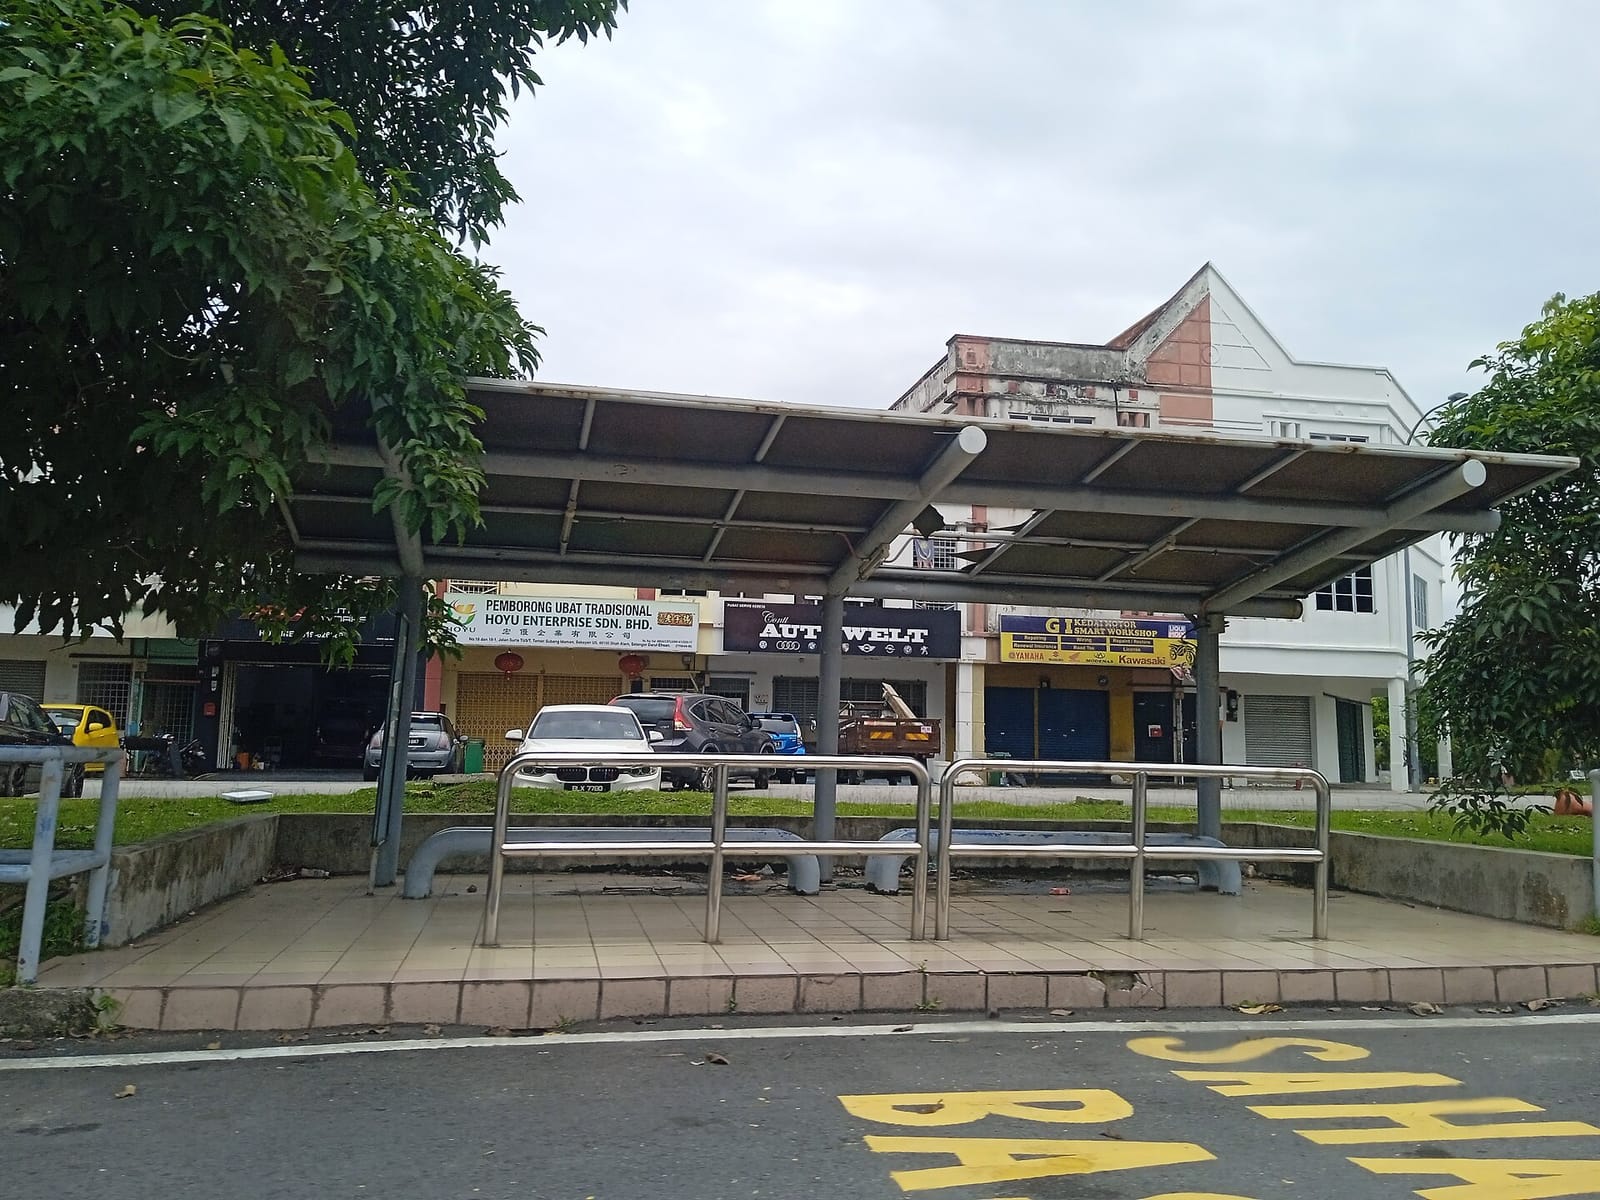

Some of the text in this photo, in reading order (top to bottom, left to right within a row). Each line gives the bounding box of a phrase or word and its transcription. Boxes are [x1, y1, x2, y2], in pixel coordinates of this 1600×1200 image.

[486, 599, 652, 617] PEMBORONG UBAT TRADISIONAL
[486, 614, 652, 630] HOYU ENTERPRISE SDN. BHD.
[1074, 627, 1158, 637] SMART WORKSHOP
[1016, 652, 1044, 660] YAMAHA
[1118, 655, 1165, 666] Kawasaki
